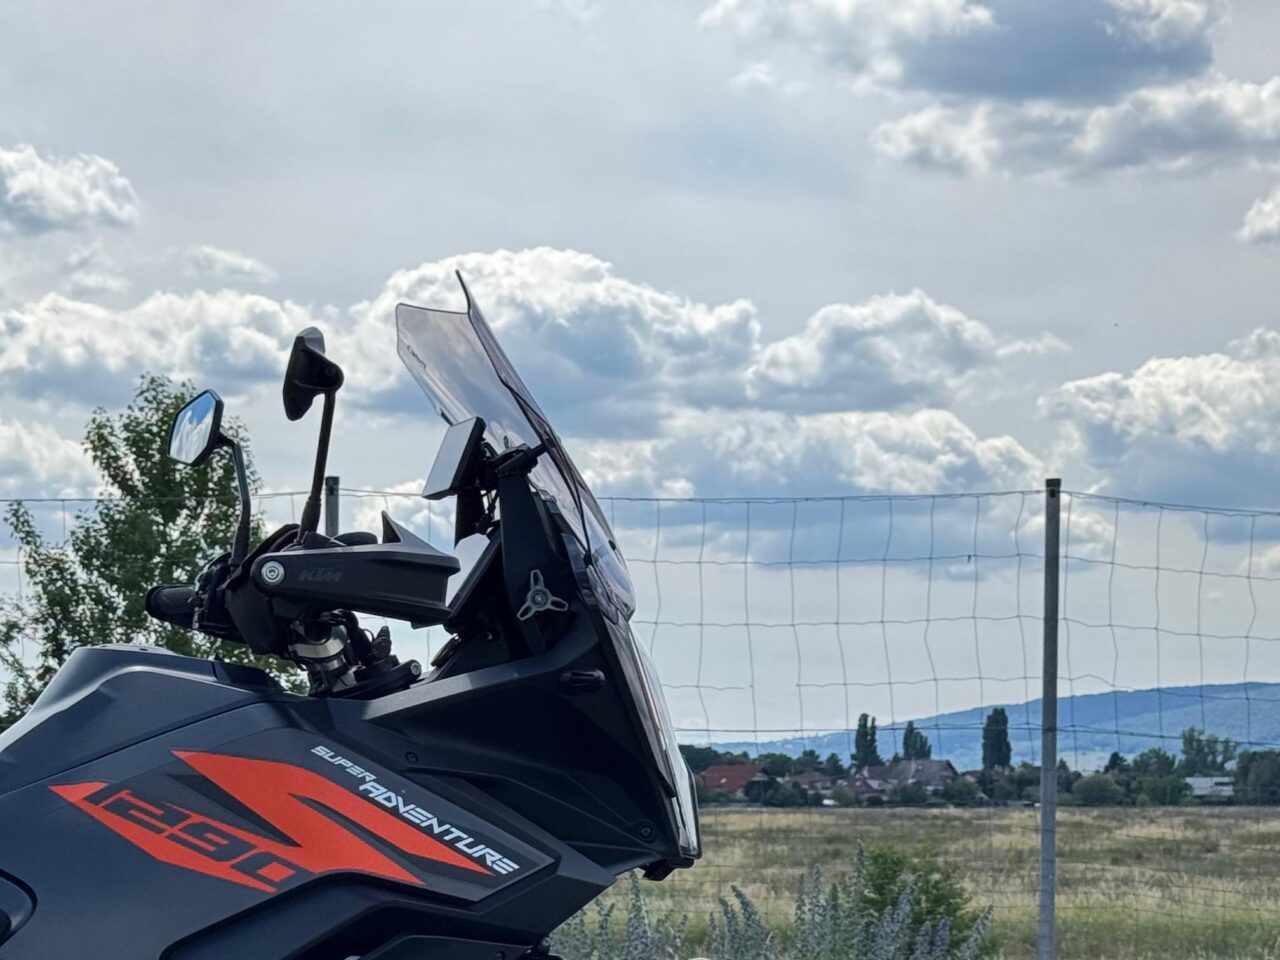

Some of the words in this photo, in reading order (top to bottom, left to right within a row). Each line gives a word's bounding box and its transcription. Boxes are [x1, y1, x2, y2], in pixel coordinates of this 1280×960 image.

[309, 744, 378, 782] SUPER
[82, 782, 314, 885] 1290
[359, 780, 520, 875] ADVENTURE
